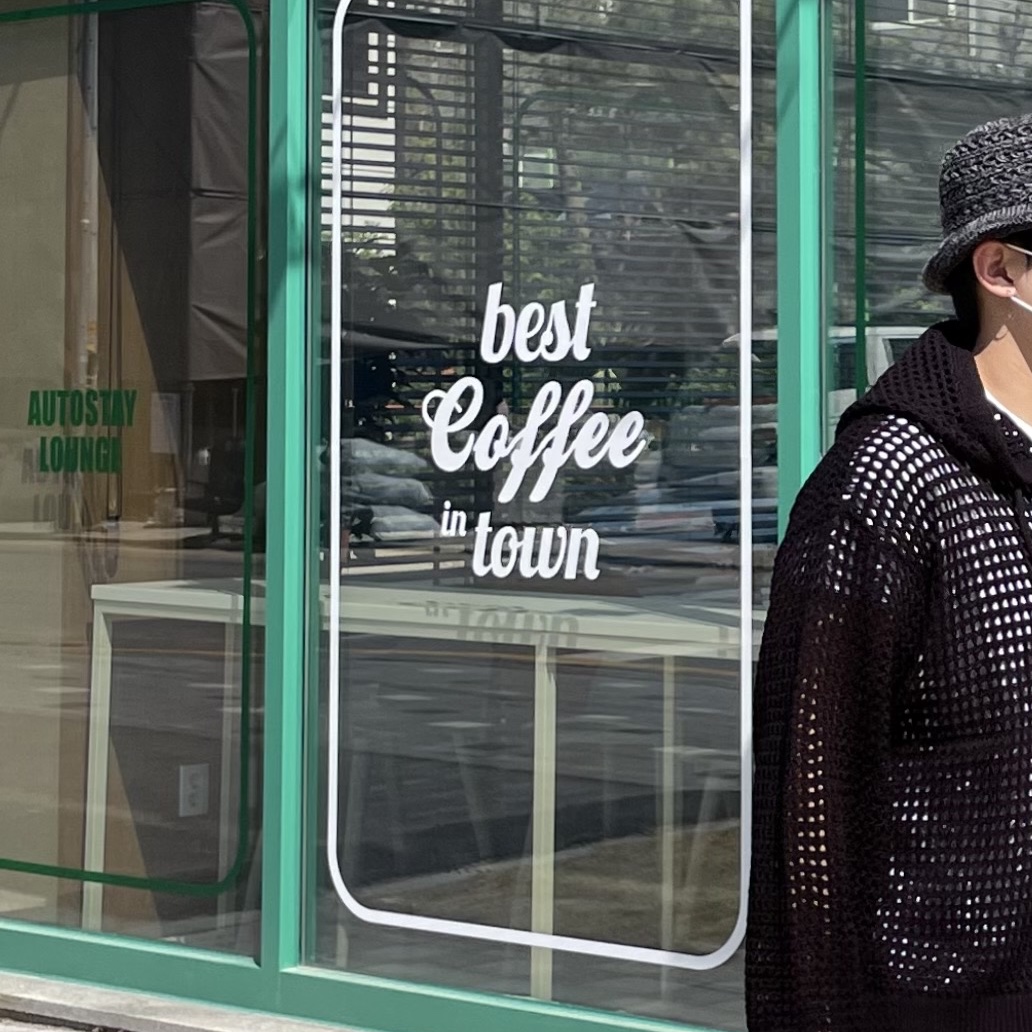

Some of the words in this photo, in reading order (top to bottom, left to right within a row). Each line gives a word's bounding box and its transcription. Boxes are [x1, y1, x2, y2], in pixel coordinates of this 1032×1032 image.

[481, 283, 597, 363] best
[27, 389, 138, 427] AUTOSTAY
[421, 376, 647, 503] Coffee
[440, 501, 467, 537] in
[472, 511, 600, 580] town
